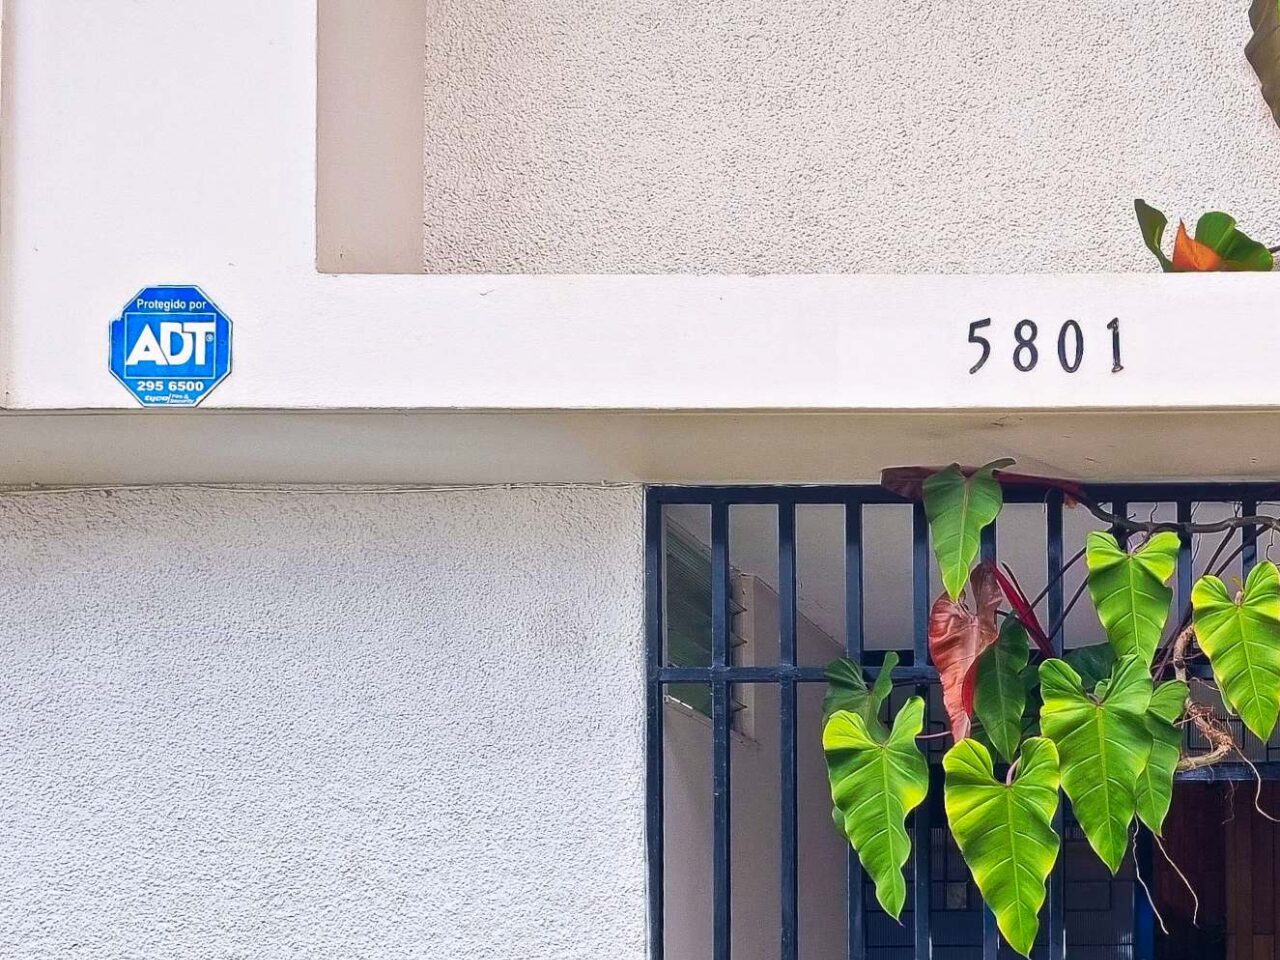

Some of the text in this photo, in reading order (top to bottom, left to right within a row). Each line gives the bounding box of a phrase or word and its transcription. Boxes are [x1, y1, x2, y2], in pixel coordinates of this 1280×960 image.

[136, 298, 207, 312] Protegido por
[126, 322, 215, 366] ADT
[968, 317, 1124, 374] 5801
[137, 381, 204, 391] 295 6500
